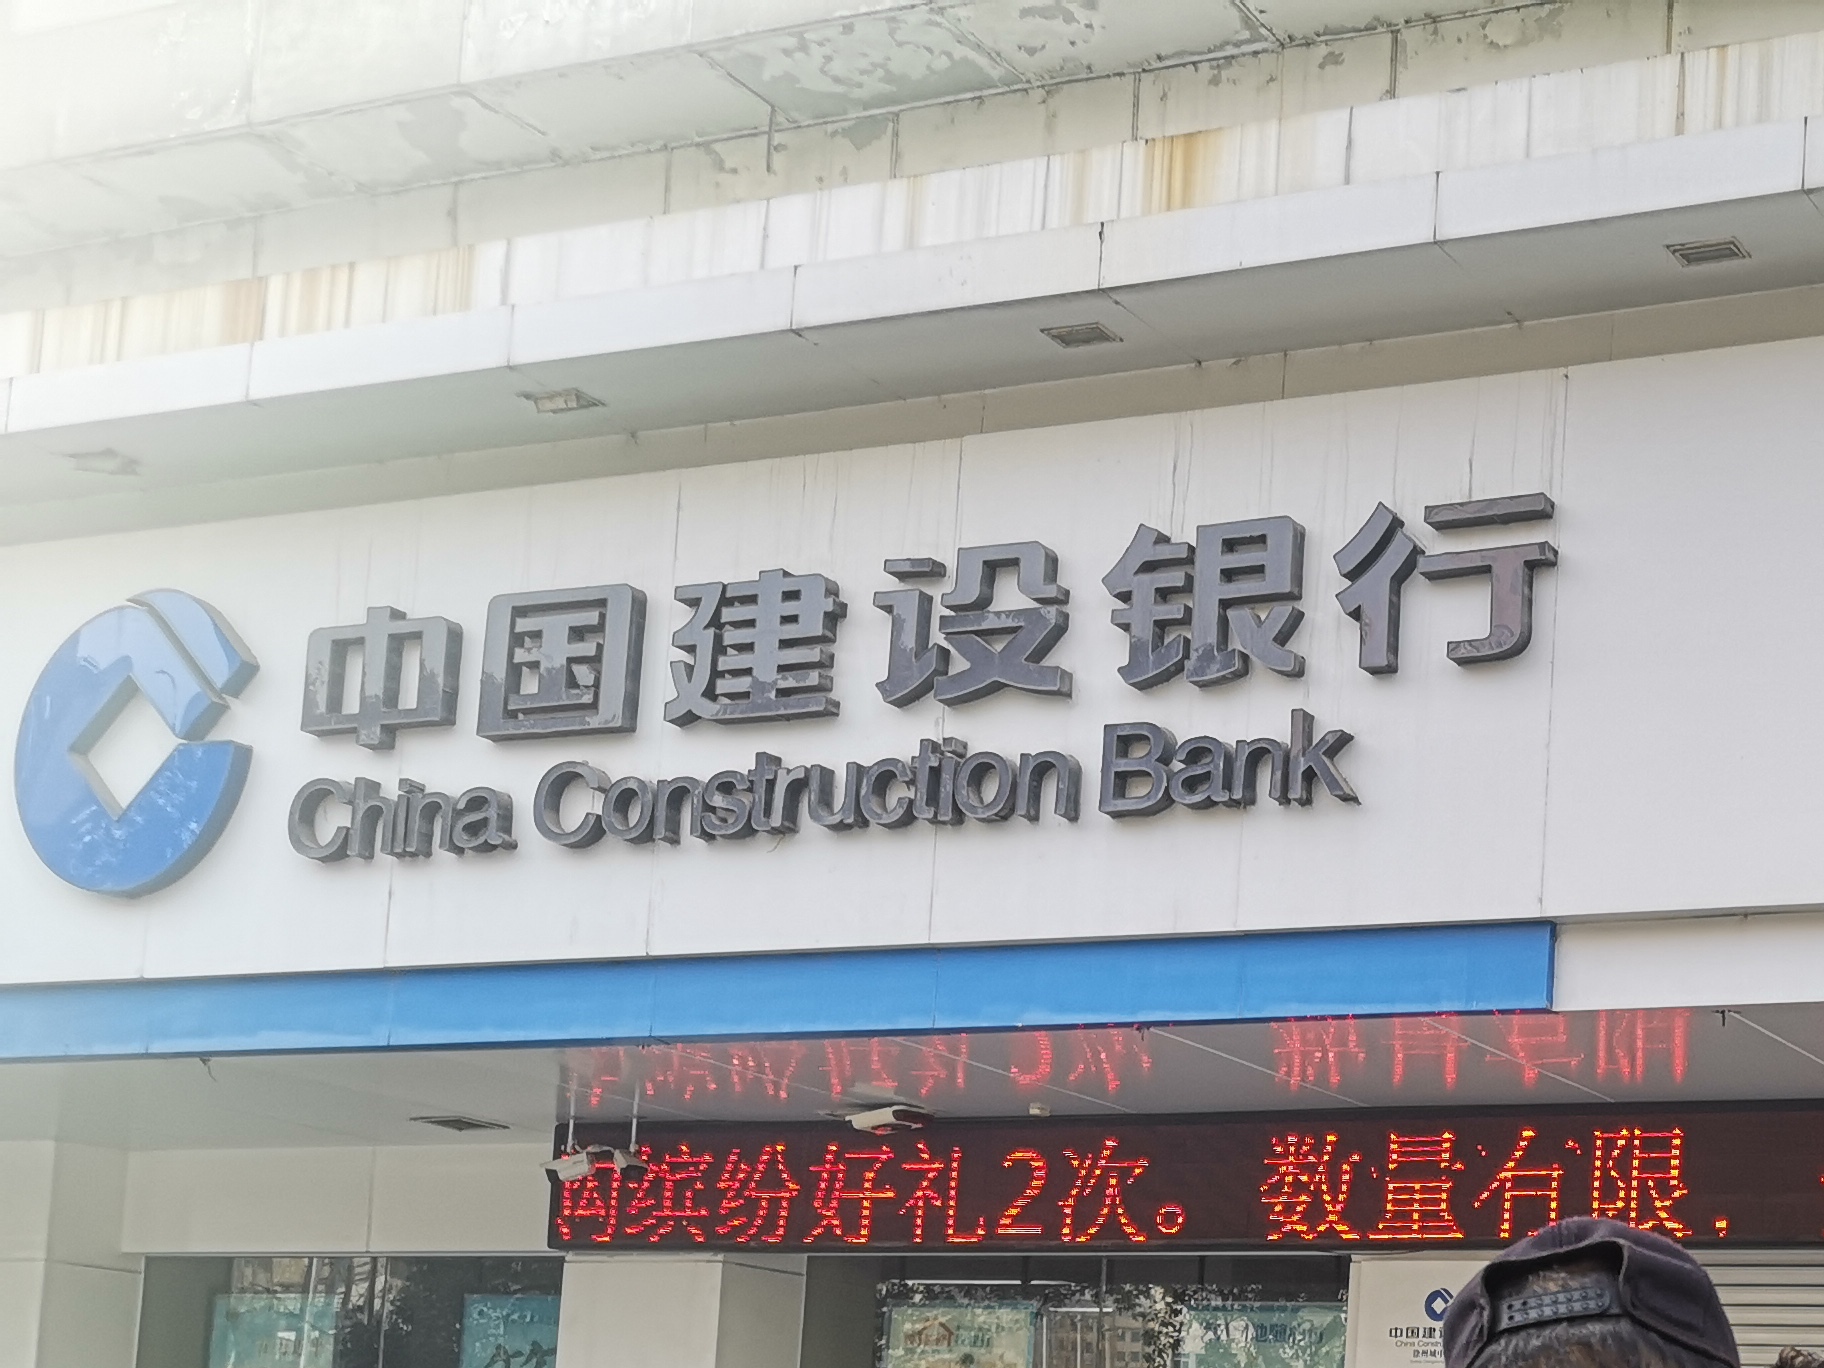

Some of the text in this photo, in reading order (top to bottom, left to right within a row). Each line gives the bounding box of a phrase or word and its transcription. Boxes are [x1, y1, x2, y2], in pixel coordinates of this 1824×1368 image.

[300, 492, 1558, 750] 中国建设银行
[287, 708, 1362, 864] China Construction Bank
